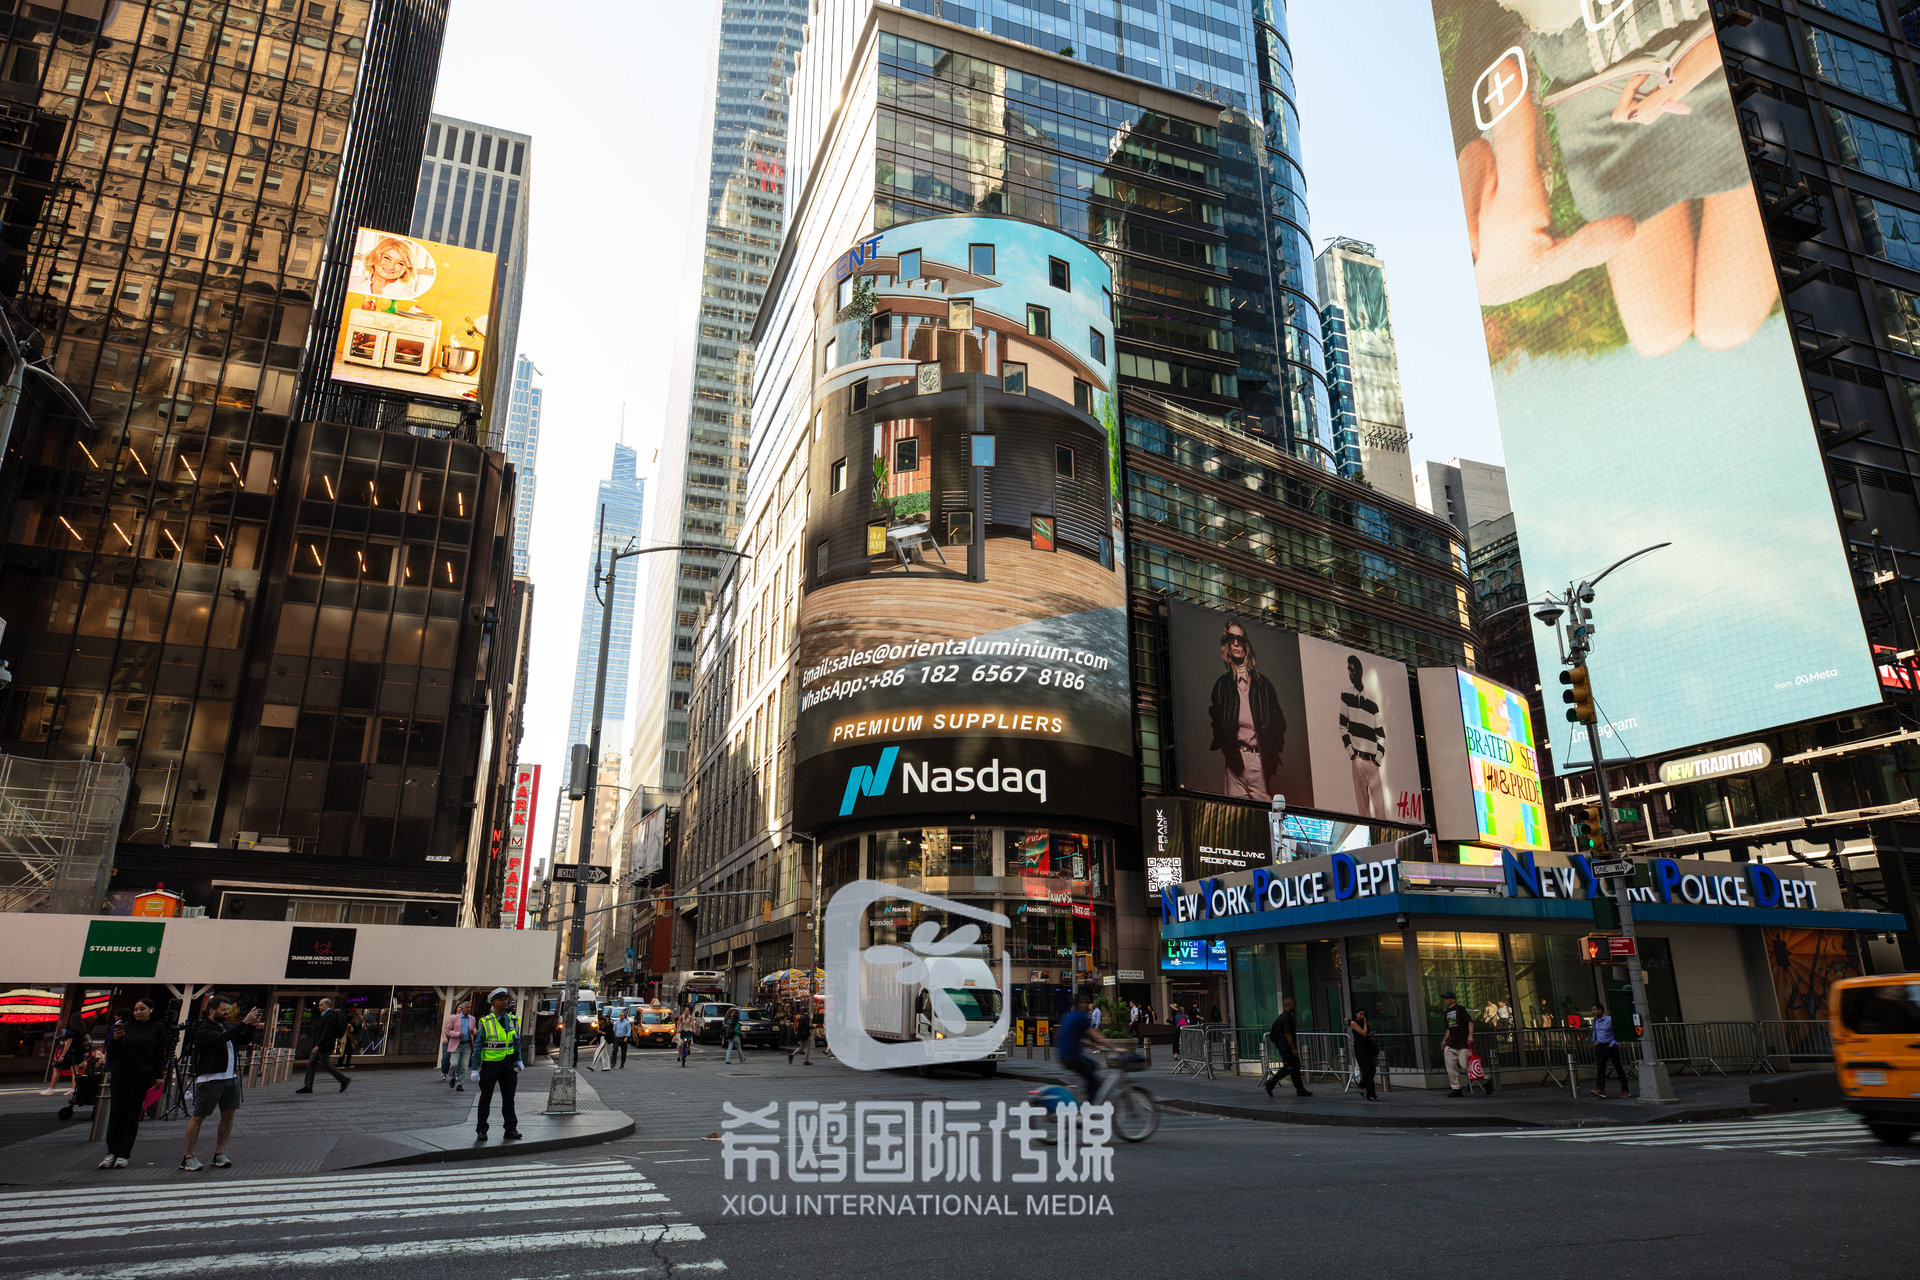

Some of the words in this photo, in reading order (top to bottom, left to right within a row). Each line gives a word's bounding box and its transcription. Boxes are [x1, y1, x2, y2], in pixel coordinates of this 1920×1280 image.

[802, 637, 1108, 688] Email:sales@orientaluminium.com
[920, 664, 959, 684] 182
[971, 664, 1028, 683] 6567
[1037, 668, 1085, 690] 8186
[1775, 681, 1793, 690] from
[1809, 668, 1838, 683] Meta
[832, 715, 923, 743] PREMIUM
[932, 713, 1064, 733] SUPPLIERS
[1571, 717, 1638, 743] Insagram
[902, 759, 1047, 803] Nasdaq
[513, 772, 531, 825] PARK
[1396, 790, 1422, 822] H&M
[1156, 809, 1165, 852] FRANK
[1199, 846, 1241, 857] BOUTIQUE
[1241, 851, 1266, 859] LIVING
[1199, 856, 1247, 867] REDEFINED
[1595, 866, 1609, 874] ONE
[1614, 863, 1628, 872] WAY
[1654, 858, 1749, 907] POLICE
[1746, 863, 1818, 909] DEPT
[503, 857, 521, 913] PARK
[1199, 878, 1251, 919] YORK
[1253, 868, 1326, 912] POLICE
[1331, 853, 1398, 900] DEPT
[1026, 905, 1047, 914] Nasdaq
[89, 945, 142, 953] STARBUCKS
